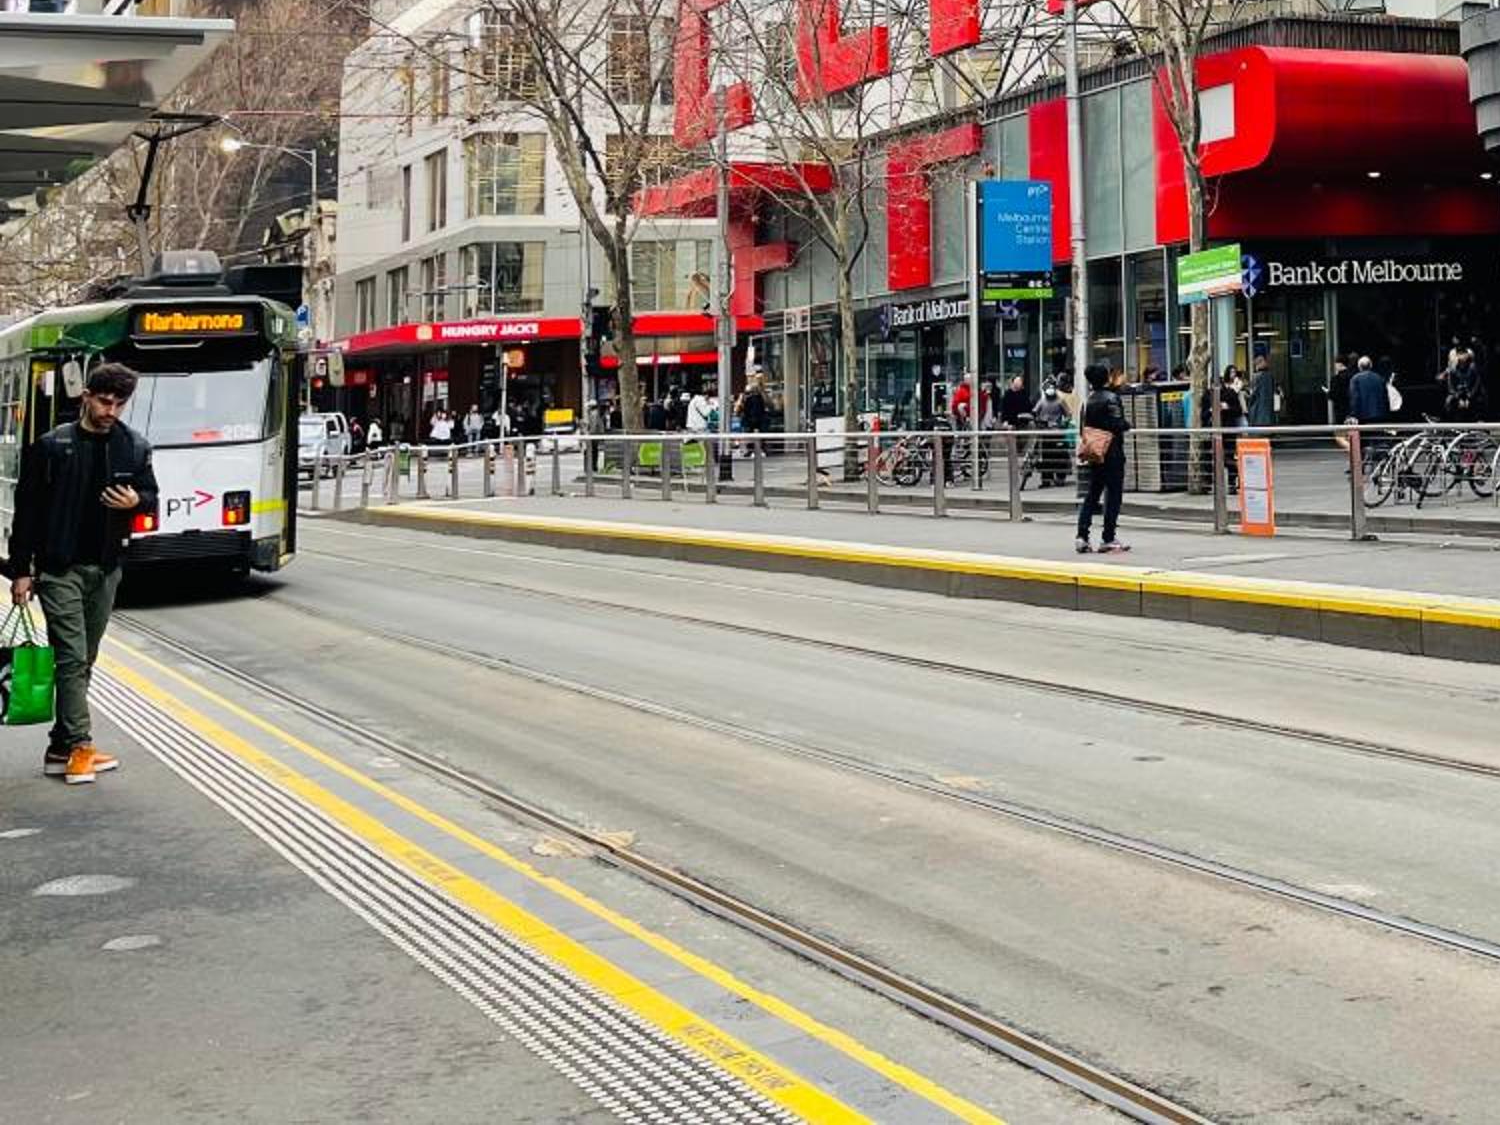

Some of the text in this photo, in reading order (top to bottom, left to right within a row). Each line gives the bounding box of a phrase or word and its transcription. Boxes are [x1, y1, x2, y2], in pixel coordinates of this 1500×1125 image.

[1267, 259, 1463, 286] Bank of Melbourne
[892, 298, 971, 326] Bank of Melbourn
[441, 324, 497, 338] HUNGRY
